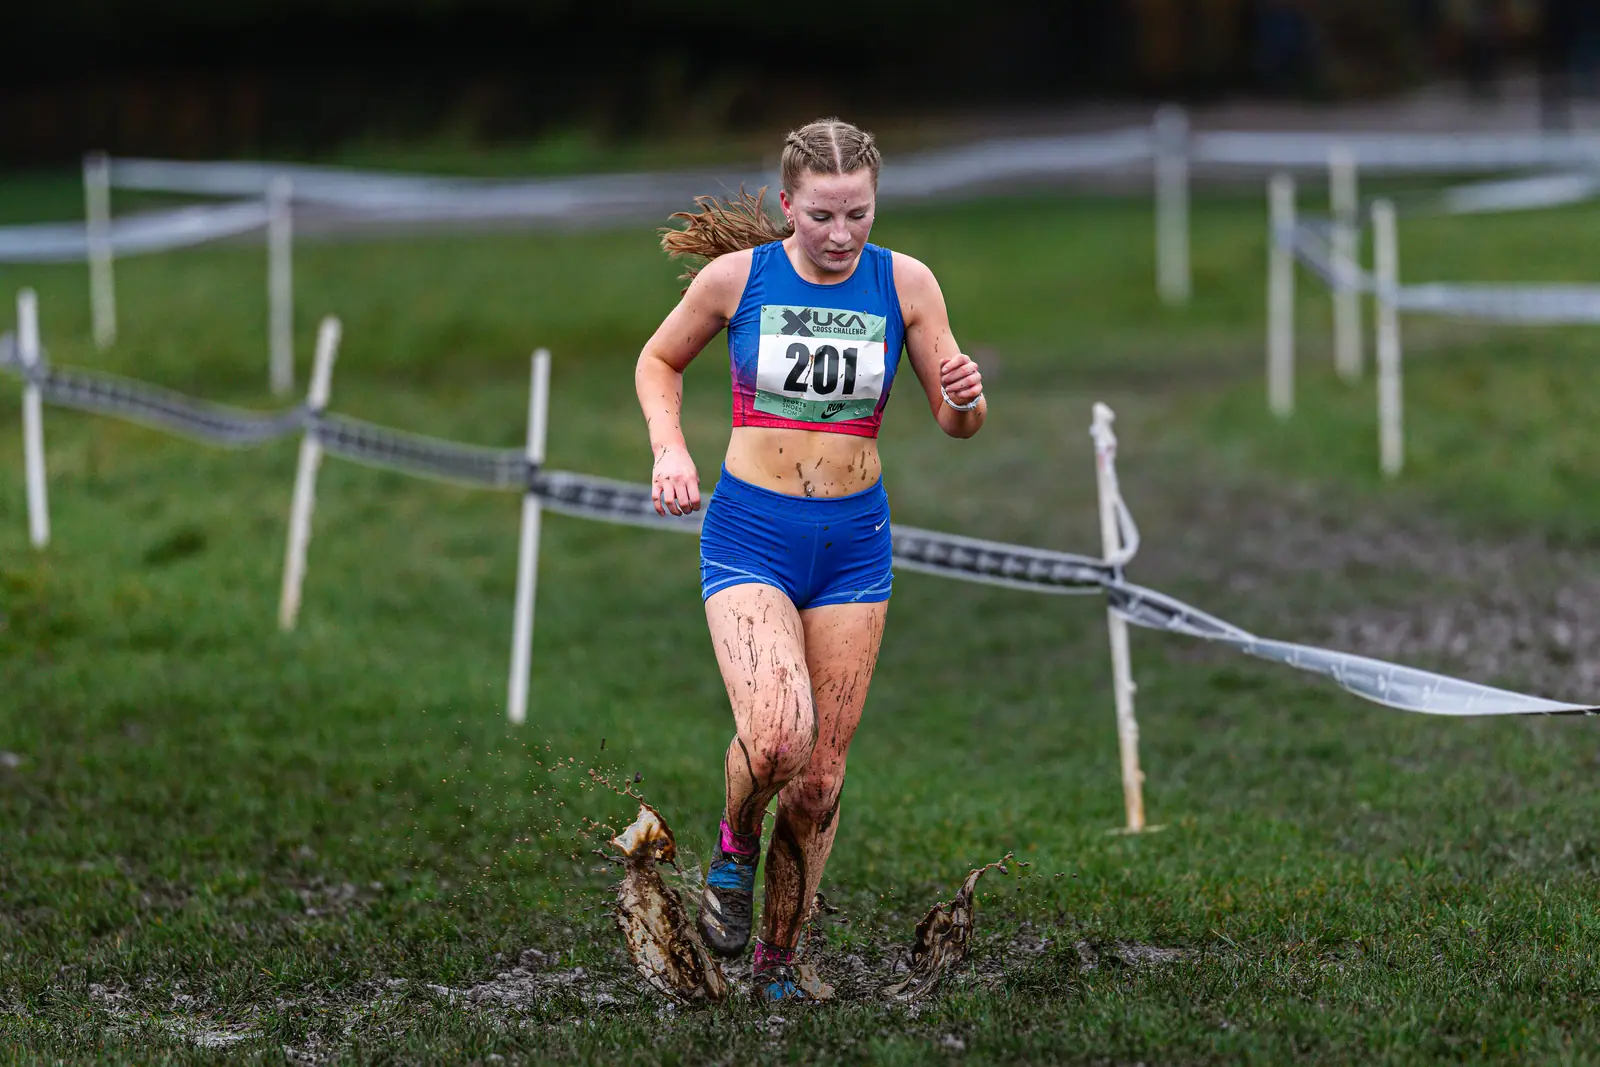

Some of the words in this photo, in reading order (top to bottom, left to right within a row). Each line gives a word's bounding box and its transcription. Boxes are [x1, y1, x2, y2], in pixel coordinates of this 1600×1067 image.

[813, 311, 867, 330] UKA
[812, 325, 832, 334] CROSS
[832, 327, 867, 335] CHALLENGE
[783, 342, 858, 395] 201
[826, 402, 846, 413] RUN
